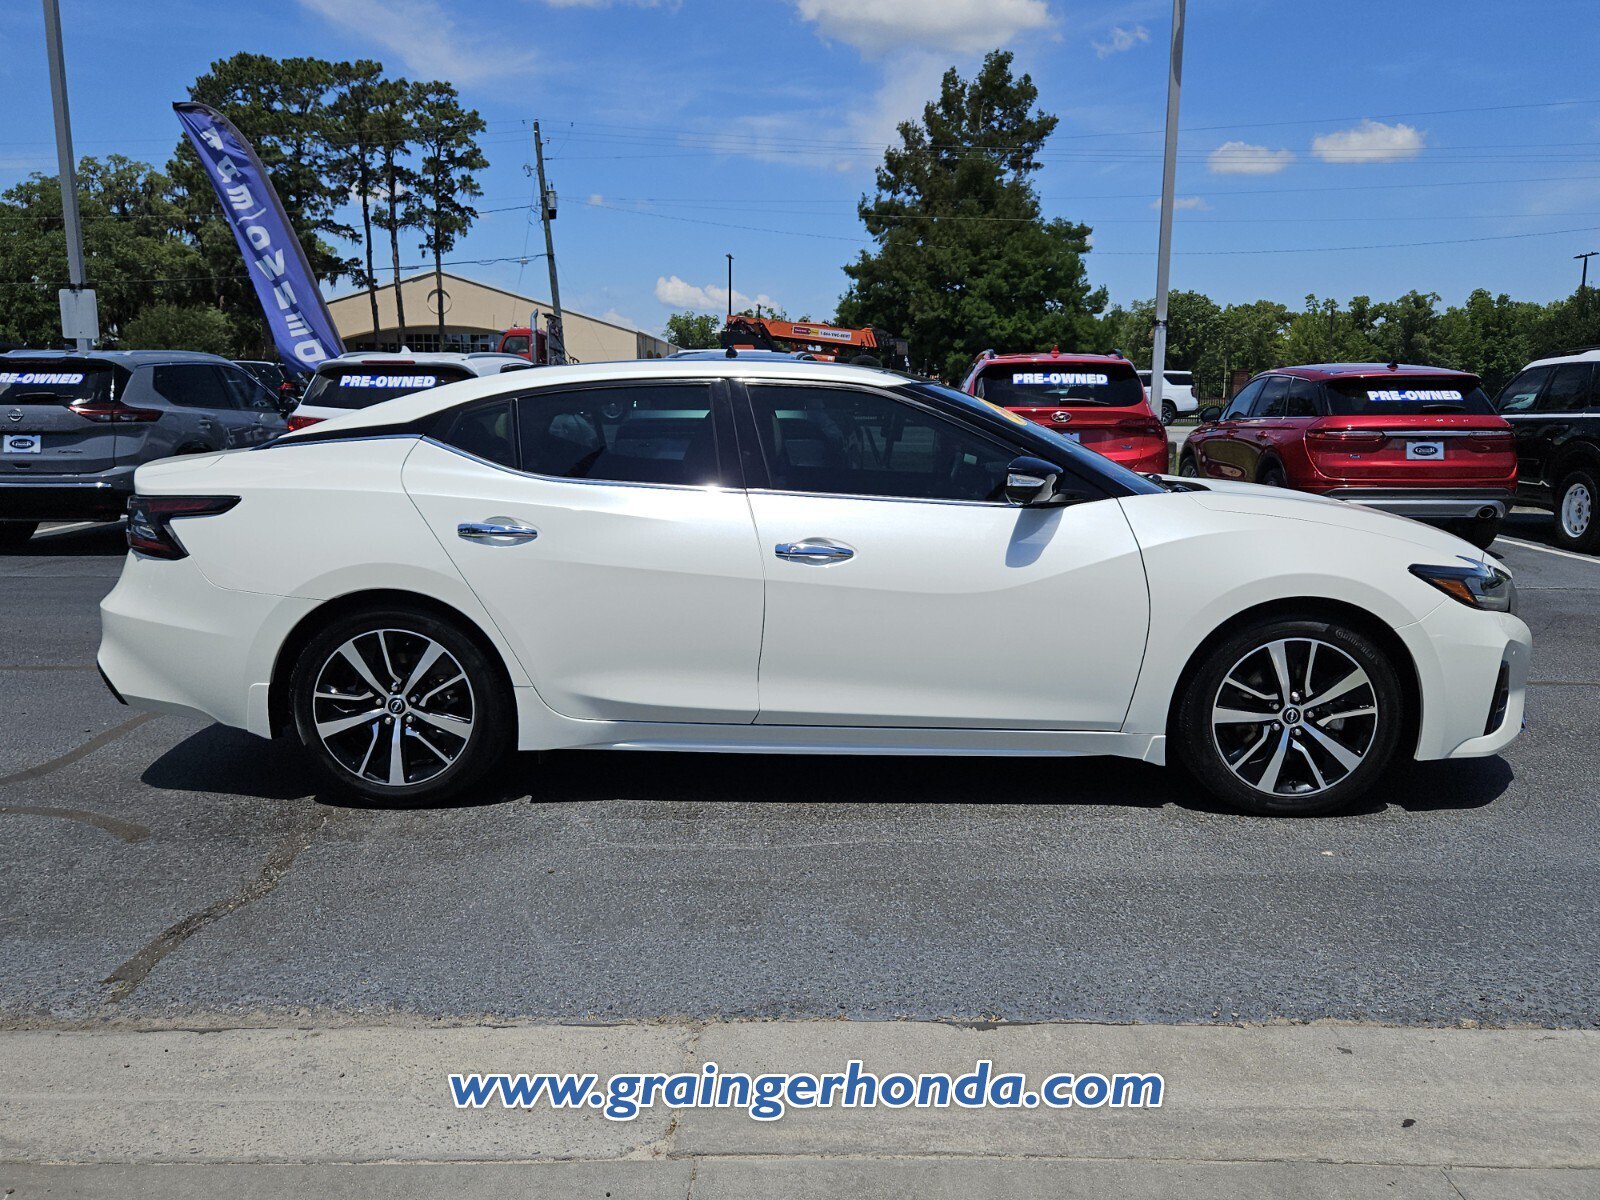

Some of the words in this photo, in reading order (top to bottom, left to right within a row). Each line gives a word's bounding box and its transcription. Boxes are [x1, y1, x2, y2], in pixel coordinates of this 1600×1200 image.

[340, 375, 436, 388] PRE-OWNED
[1012, 373, 1108, 385] PRE-OWNED
[1366, 390, 1462, 401] PRE-OWNED
